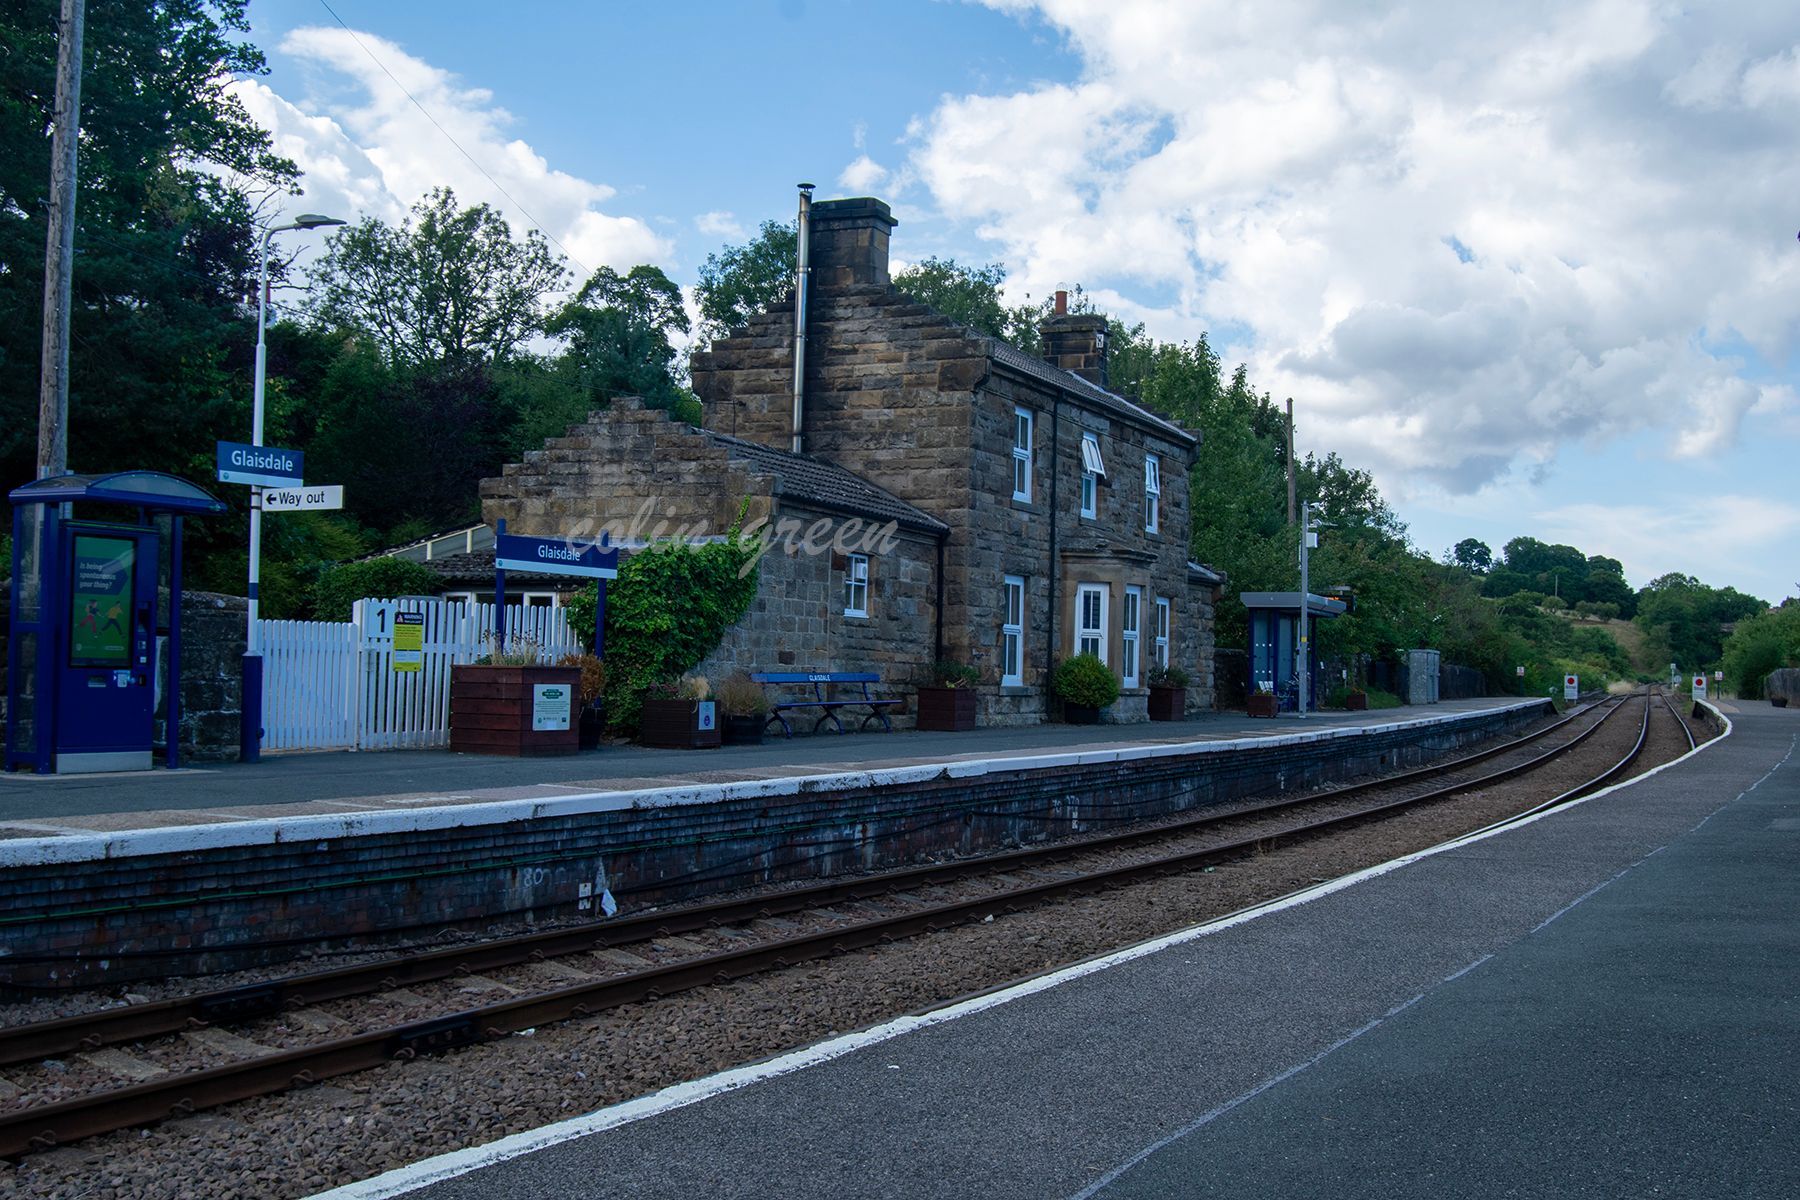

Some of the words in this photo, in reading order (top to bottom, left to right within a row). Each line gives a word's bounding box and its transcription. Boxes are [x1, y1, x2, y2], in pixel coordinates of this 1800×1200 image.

[231, 450, 294, 472] Glaisdale
[279, 492, 302, 507] Way
[306, 491, 325, 504] out
[537, 545, 581, 562] Glaisdale
[376, 608, 386, 633] 1
